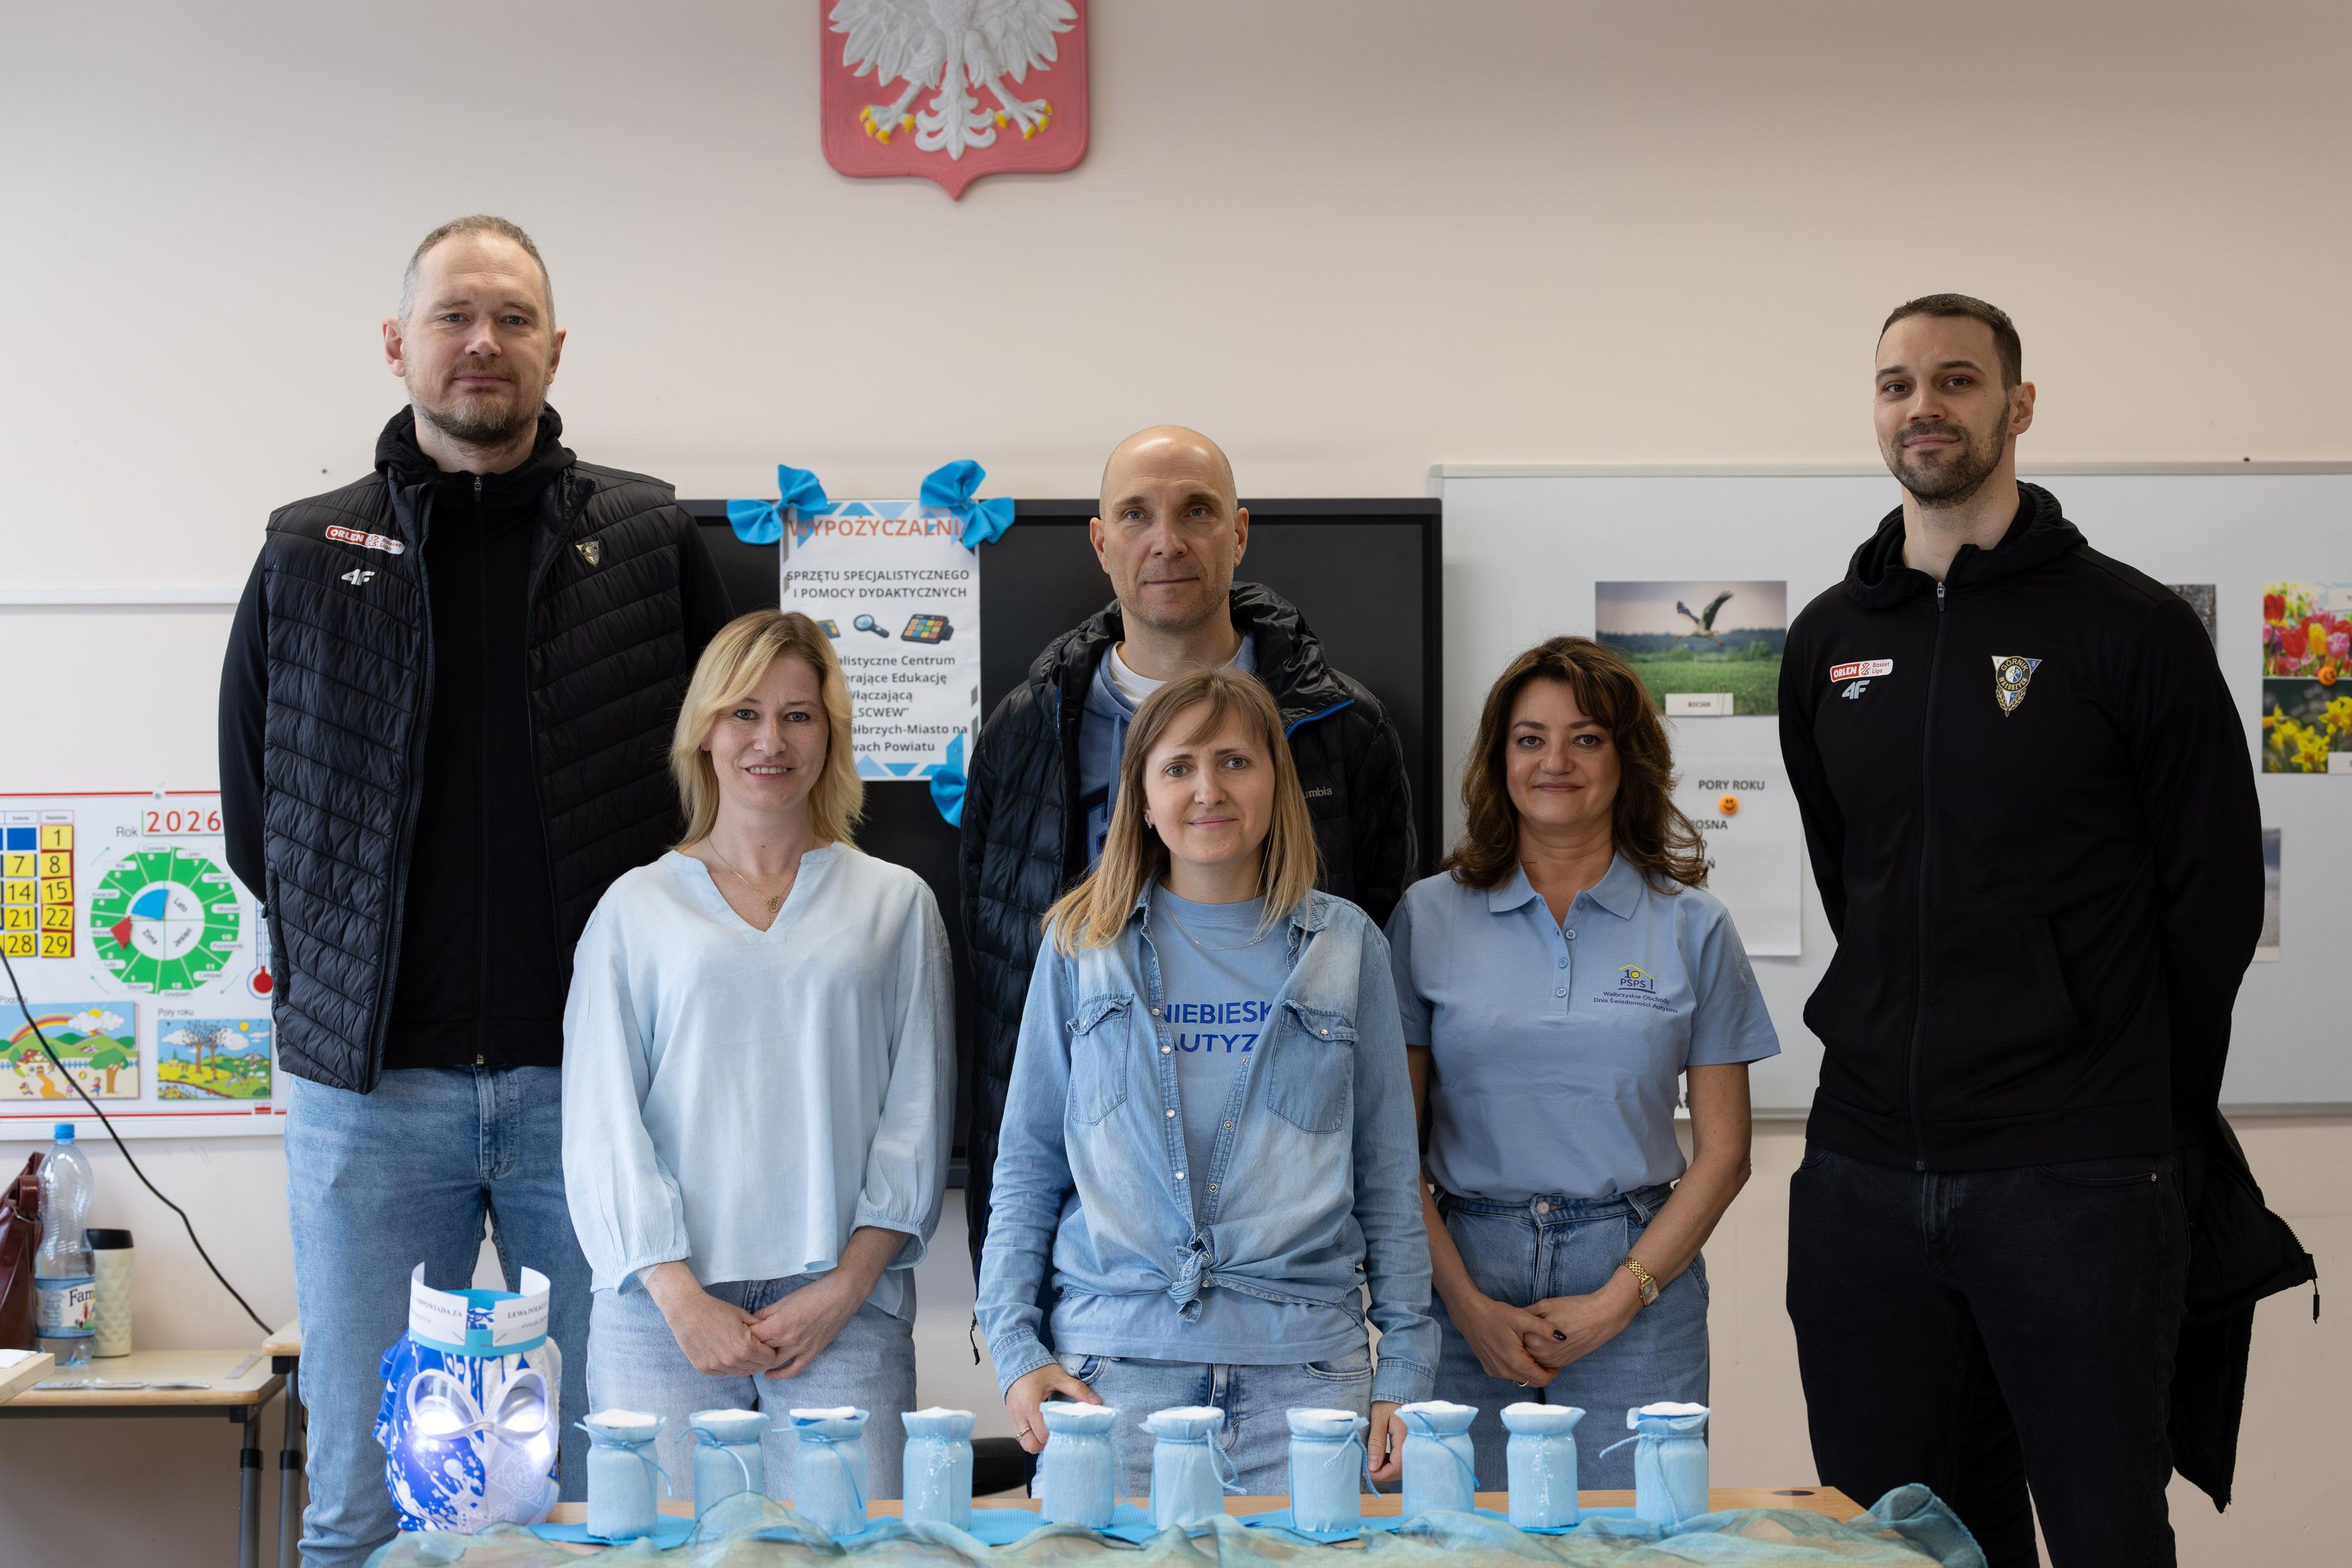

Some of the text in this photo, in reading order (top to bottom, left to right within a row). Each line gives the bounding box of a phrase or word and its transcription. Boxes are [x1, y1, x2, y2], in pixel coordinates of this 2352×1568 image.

[330, 529, 364, 542] ORLEN
[382, 538, 402, 548] Basket
[341, 568, 375, 586] 4F
[786, 570, 970, 583] SPRZĘTU SPECJALISTYCZNEGO
[794, 587, 967, 598] I POMOCY DYDAKTYCZNYCH
[839, 656, 956, 669] listyczne Centrum
[1833, 666, 1857, 678] ORLEN
[892, 673, 947, 686] Edukację
[1841, 680, 1870, 699] 4F
[852, 725, 949, 737] ałbrzych-Miasto
[885, 742, 935, 752] Powiatu
[1698, 780, 1765, 790] PORY ROKU
[1303, 786, 1333, 799] umbia
[53, 829, 60, 846] 1
[116, 826, 138, 837] Rok
[13, 855, 61, 874] 7 8
[8, 881, 67, 901] 14 15
[173, 897, 188, 913] Lato
[10, 908, 69, 927] 21 22
[142, 929, 157, 946] Zima
[8, 935, 67, 954] 28 29
[1621, 979, 1646, 988] PSPS
[0, 995, 28, 1005] Pogoa
[1610, 998, 1651, 1007] Świadomości
[1653, 1004, 1678, 1013] Autyzmu
[1643, 995, 1670, 1006] Obchody
[158, 1008, 194, 1017] Pory roku
[1164, 1001, 1273, 1024] NIEBIESK
[1174, 1033, 1259, 1053] UTYZ
